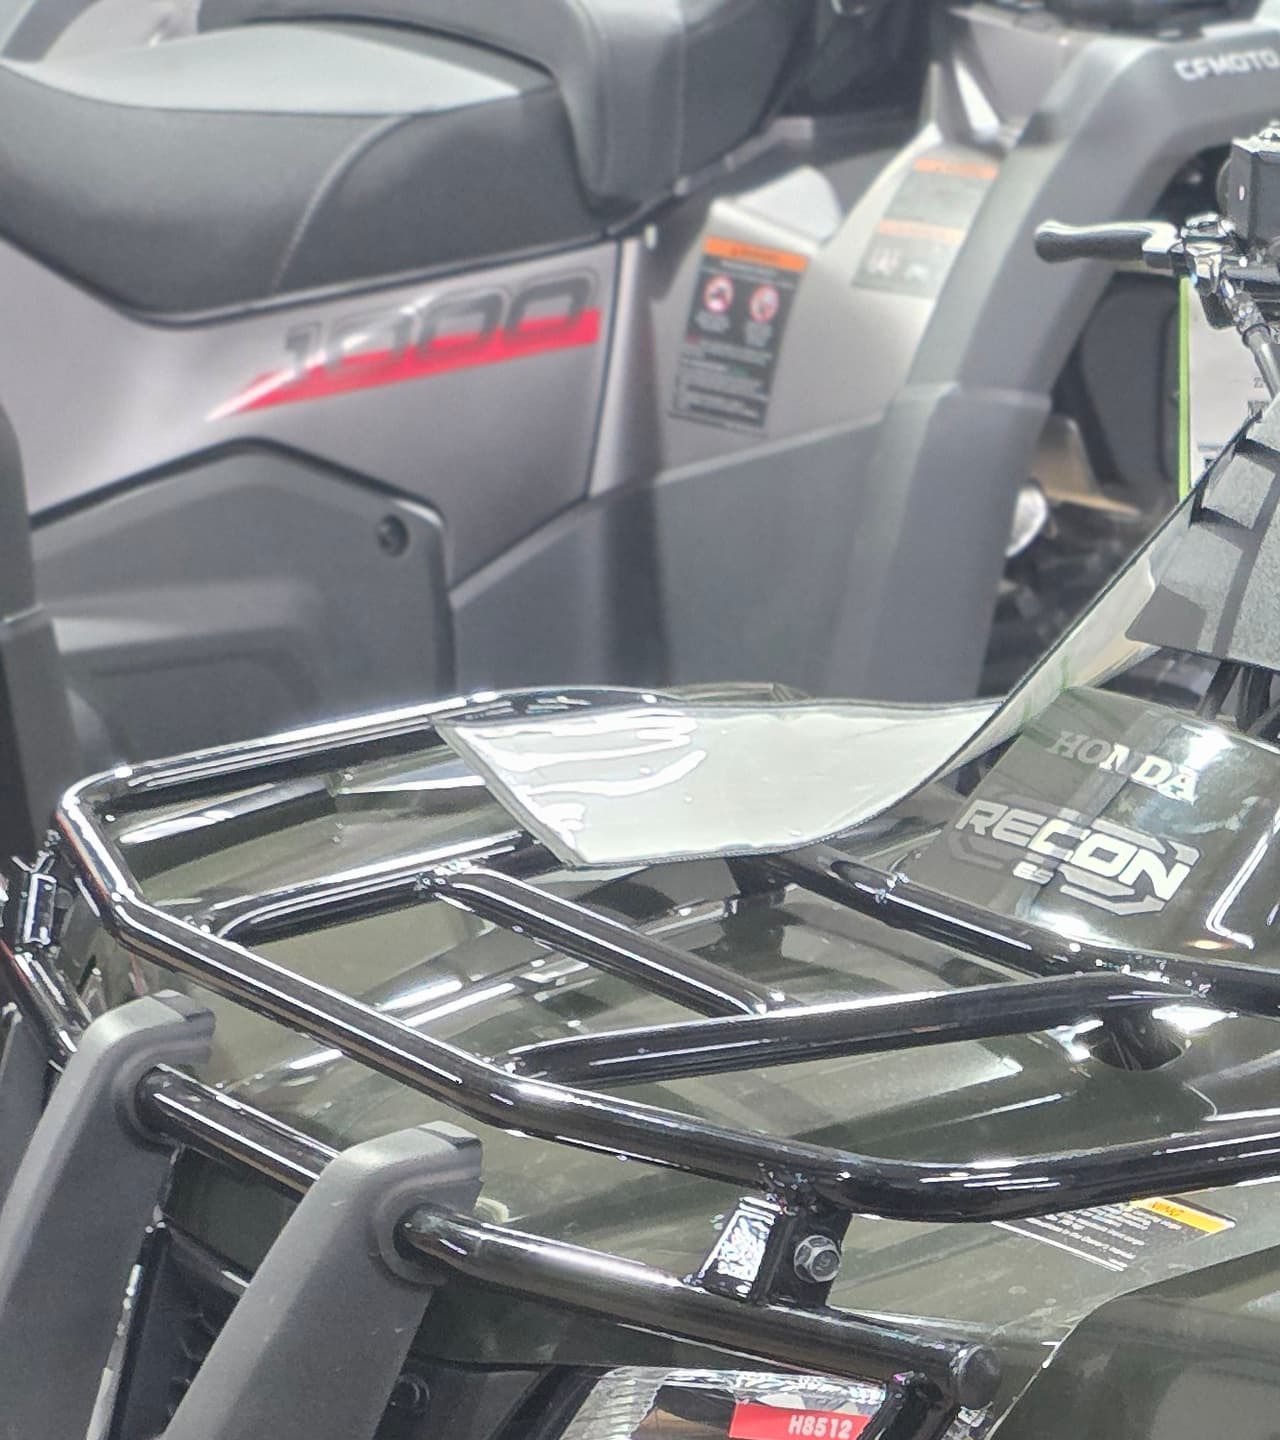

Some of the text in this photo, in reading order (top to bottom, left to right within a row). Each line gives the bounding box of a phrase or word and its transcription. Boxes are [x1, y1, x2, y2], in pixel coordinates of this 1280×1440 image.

[285, 270, 598, 386] 1000
[1045, 731, 1200, 804] HONDA
[954, 799, 1191, 901] RECON
[787, 1414, 853, 1440] H8512
